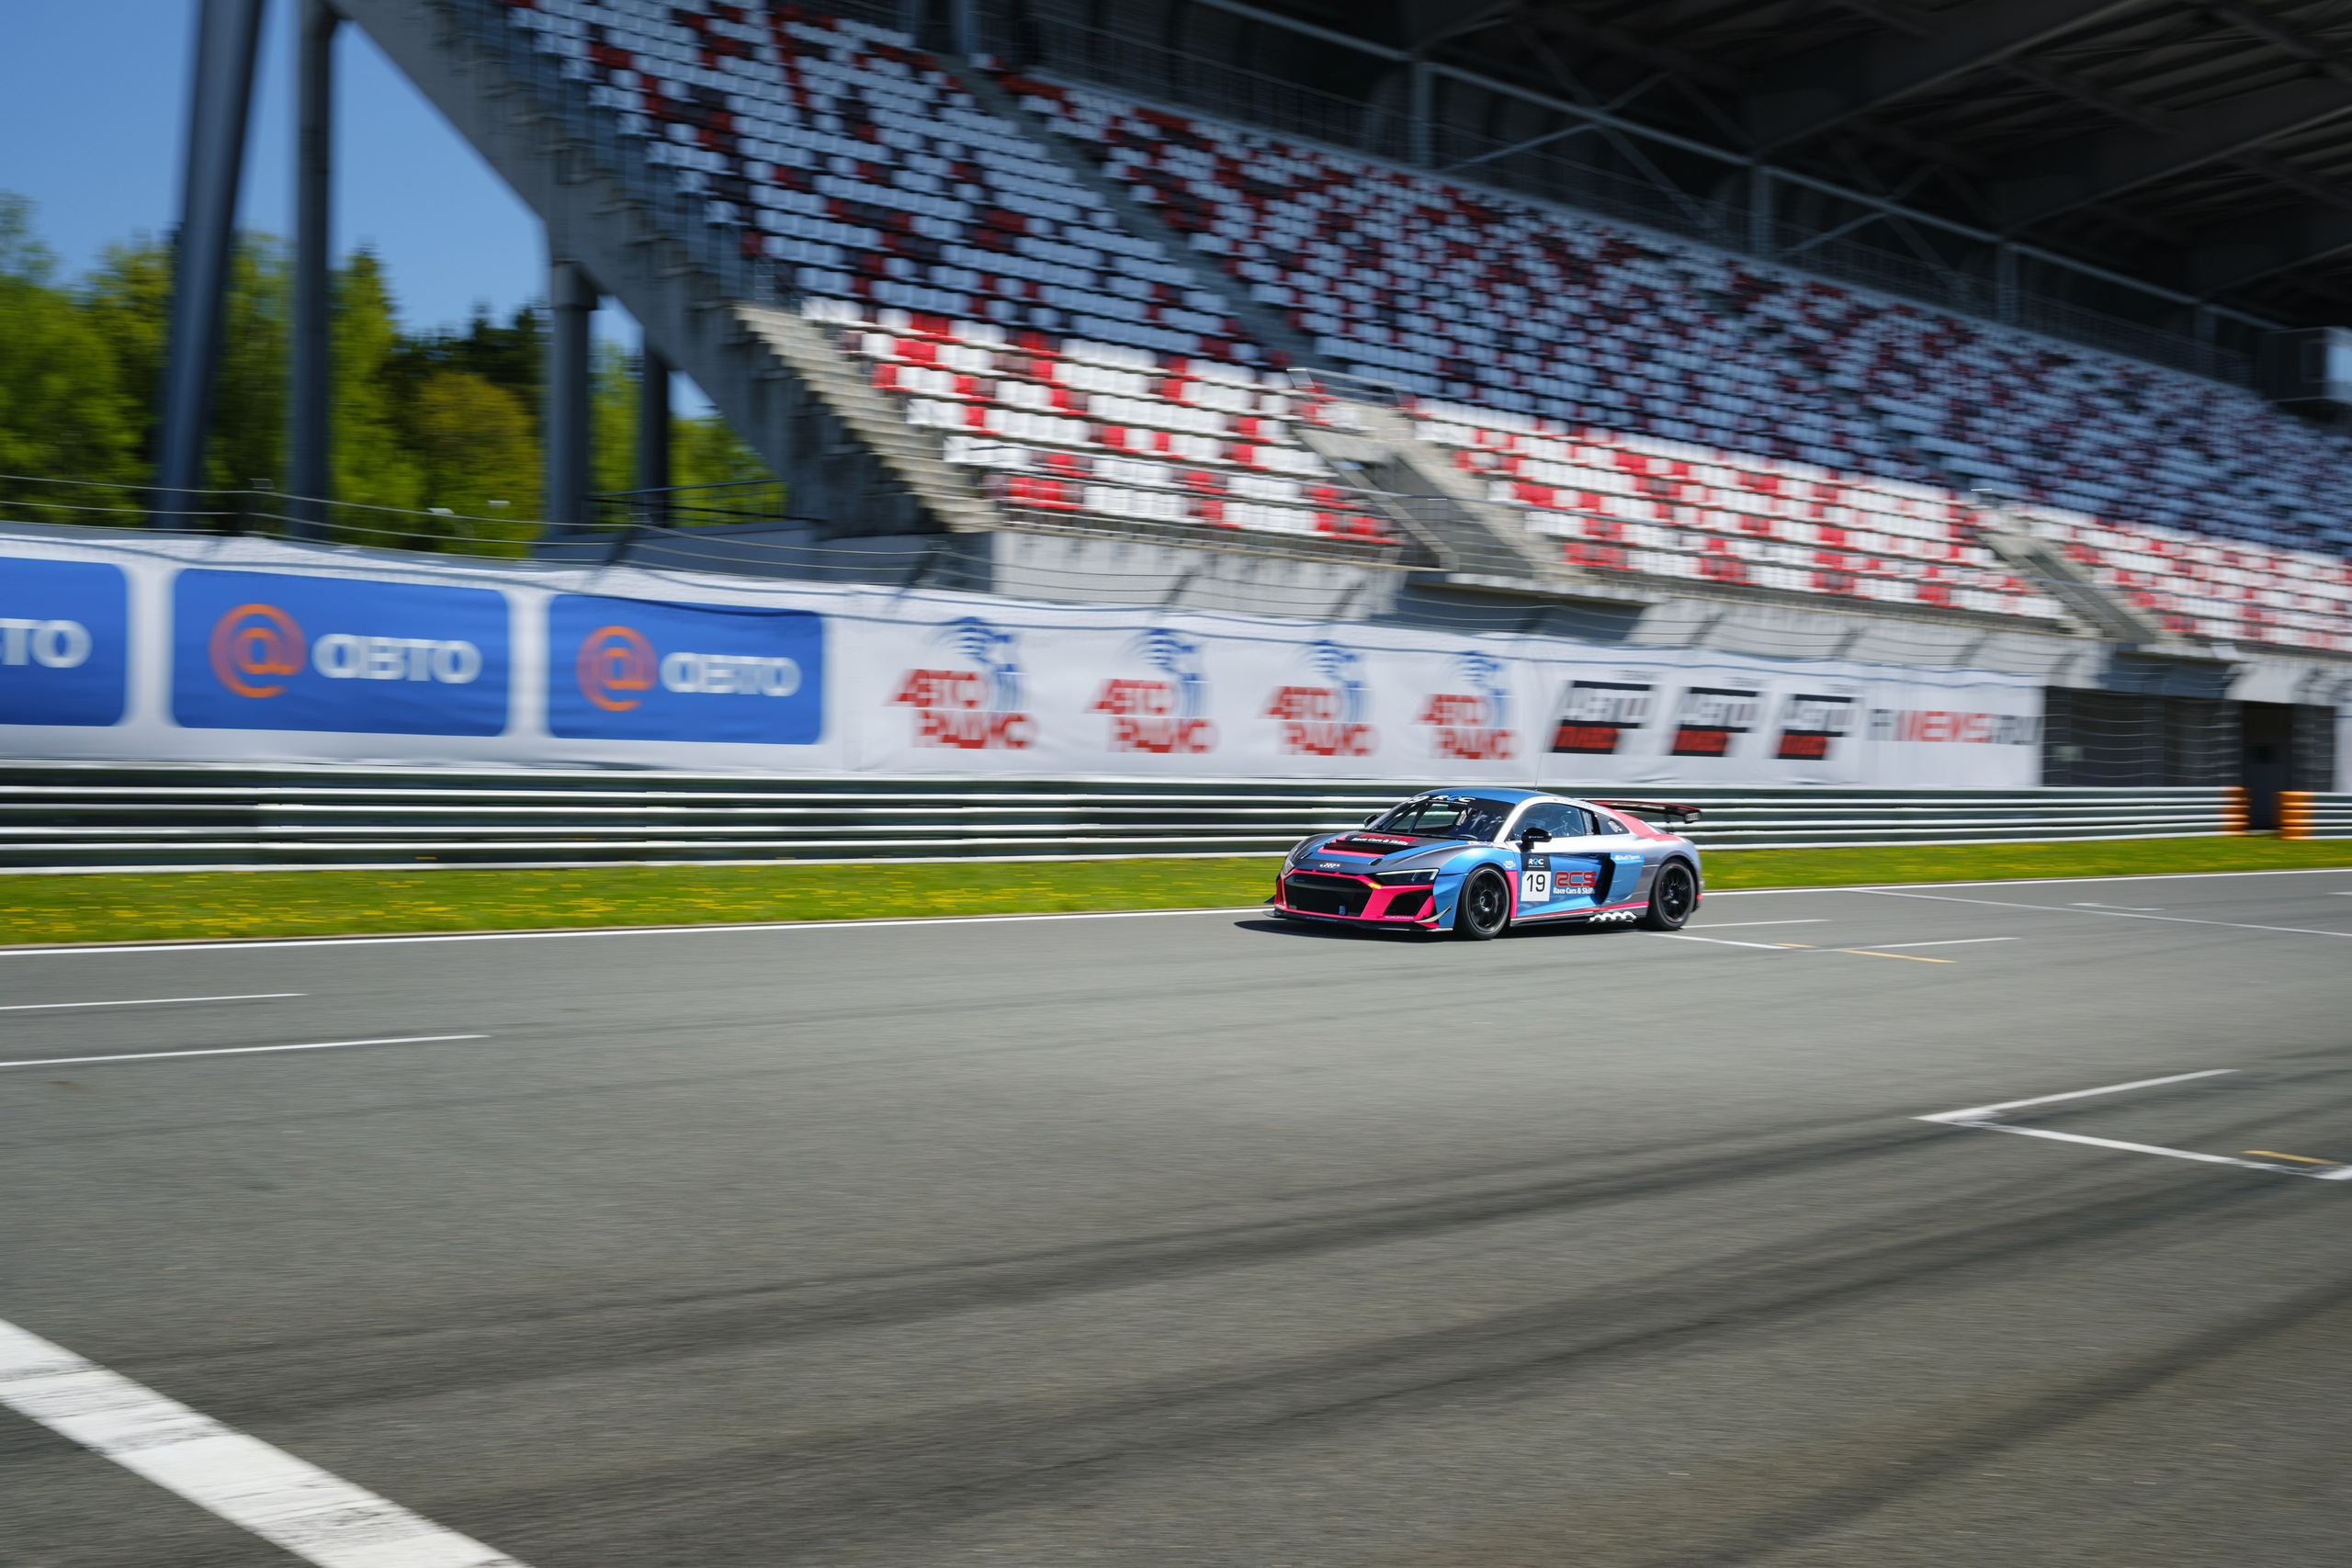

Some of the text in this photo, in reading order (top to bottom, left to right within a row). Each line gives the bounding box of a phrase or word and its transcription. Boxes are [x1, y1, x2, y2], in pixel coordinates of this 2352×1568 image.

[886, 669, 989, 709] АВТО
[1086, 679, 1177, 716] АВТО
[1526, 874, 1545, 892] 19
[1554, 871, 1597, 886] RCS
